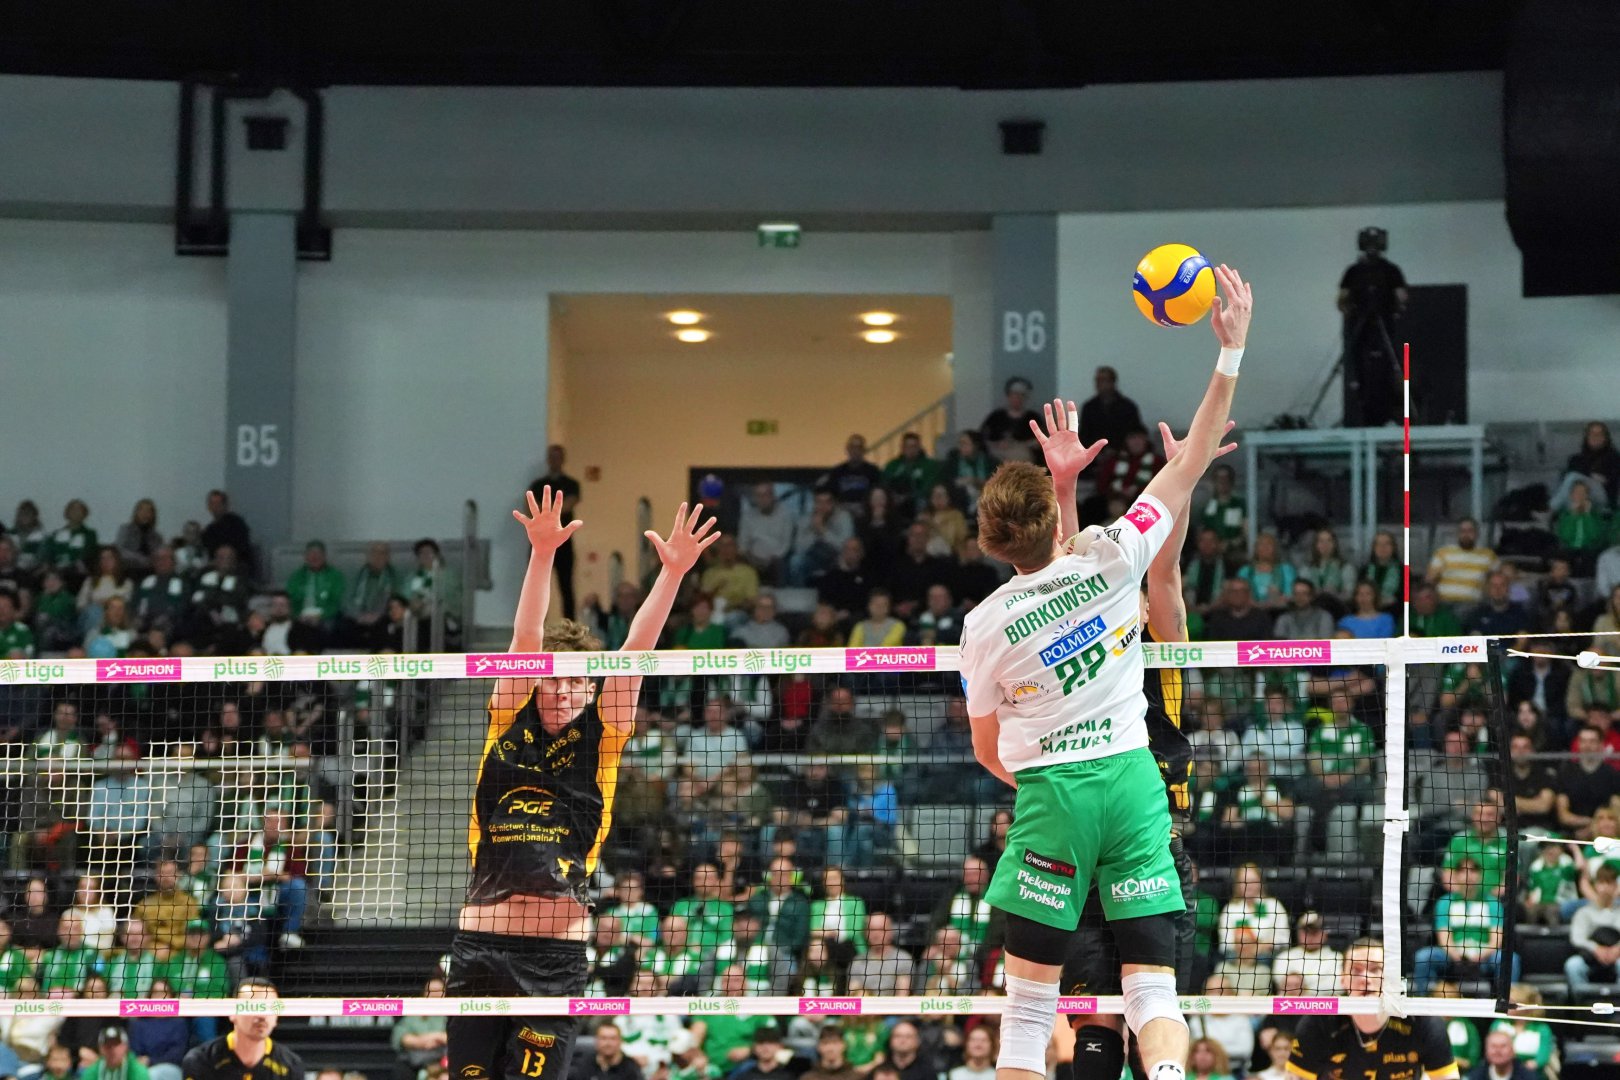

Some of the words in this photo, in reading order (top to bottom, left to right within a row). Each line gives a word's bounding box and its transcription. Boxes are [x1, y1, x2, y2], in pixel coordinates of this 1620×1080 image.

[1003, 310, 1046, 352] B6
[237, 424, 279, 467] B5
[1005, 589, 1036, 610] plus
[1051, 572, 1082, 590] liga
[1004, 573, 1109, 645] BORKOWSKI
[1042, 618, 1103, 664] POLMLEK
[1442, 644, 1479, 654] netex
[692, 651, 737, 672] plus
[770, 651, 812, 671] liga
[874, 653, 927, 665] TAURON
[1160, 644, 1202, 666] liga
[1267, 647, 1322, 659] TAURON
[25, 661, 64, 681] liga
[123, 664, 174, 676] TAURON
[213, 658, 258, 678] plus
[317, 657, 361, 678] plus
[393, 656, 433, 677] liga
[494, 659, 546, 670] TAURON
[586, 653, 632, 673] plus
[1041, 732, 1113, 756] MAZURY
[508, 800, 553, 817] PGE
[1017, 869, 1071, 895] Piekarnia
[1112, 878, 1168, 896] KOMA
[1019, 884, 1065, 909] Tyrolska
[14, 1001, 44, 1015] plus
[139, 1004, 174, 1012] TAURON
[235, 1001, 266, 1014] plus
[361, 1003, 397, 1011] TAURON
[460, 1000, 491, 1013] plus
[588, 1002, 624, 1010] TAURON
[688, 999, 720, 1013] plus
[818, 1002, 855, 1010] TAURON
[920, 998, 953, 1013] plus
[1294, 1001, 1332, 1010] TAURON
[521, 1048, 545, 1077] 13
[464, 1069, 480, 1077] PGE
